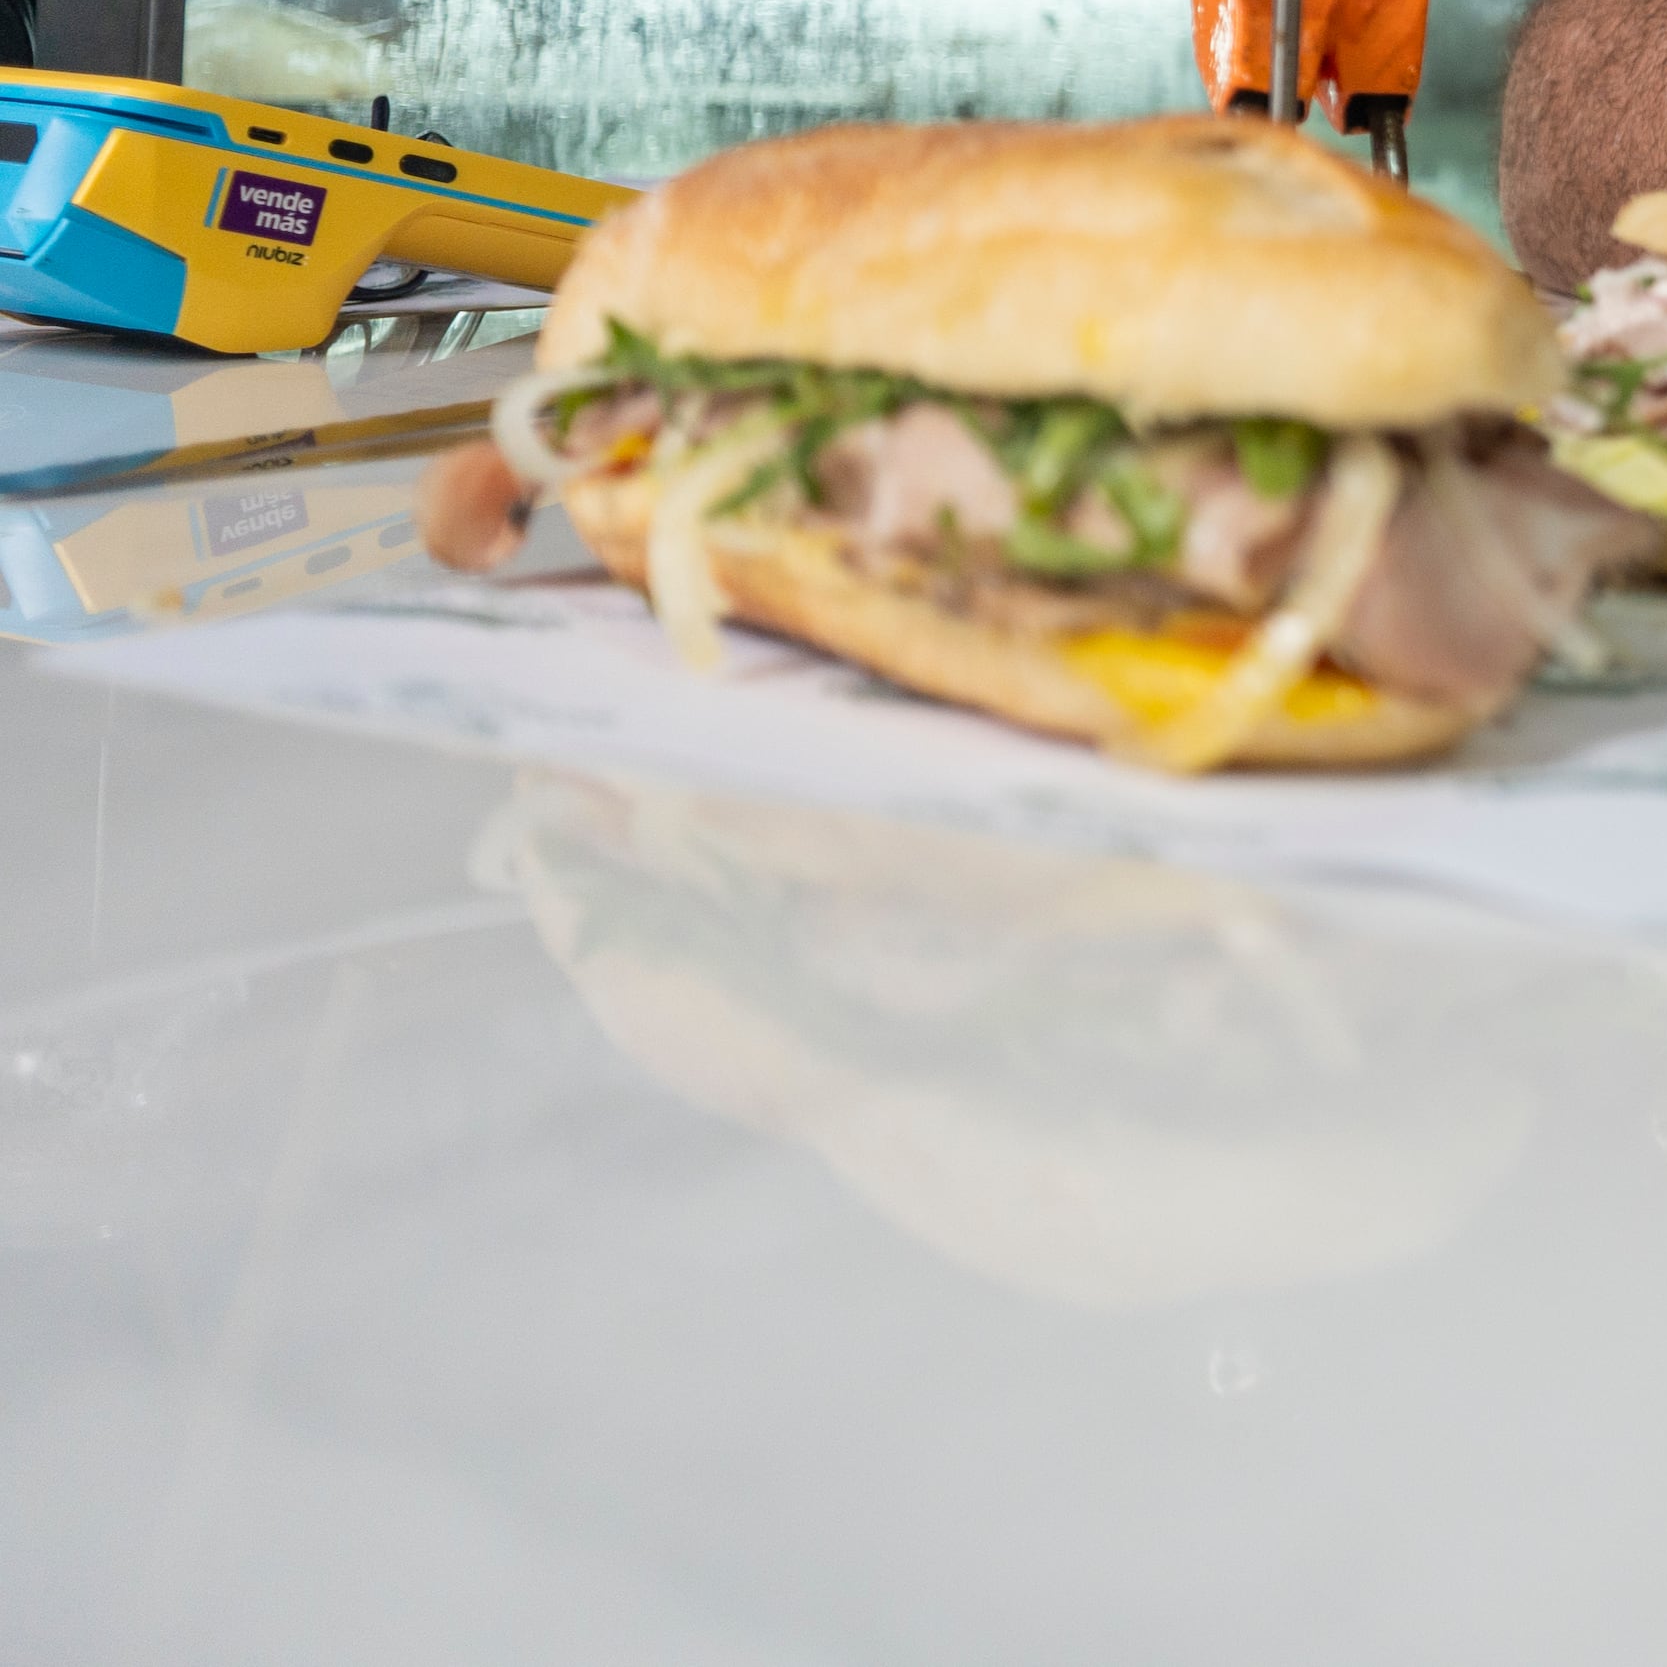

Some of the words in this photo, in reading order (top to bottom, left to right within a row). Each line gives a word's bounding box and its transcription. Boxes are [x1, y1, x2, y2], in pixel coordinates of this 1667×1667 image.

[240, 185, 315, 214] vende
[255, 210, 309, 235] más
[246, 244, 305, 266] niubiz
